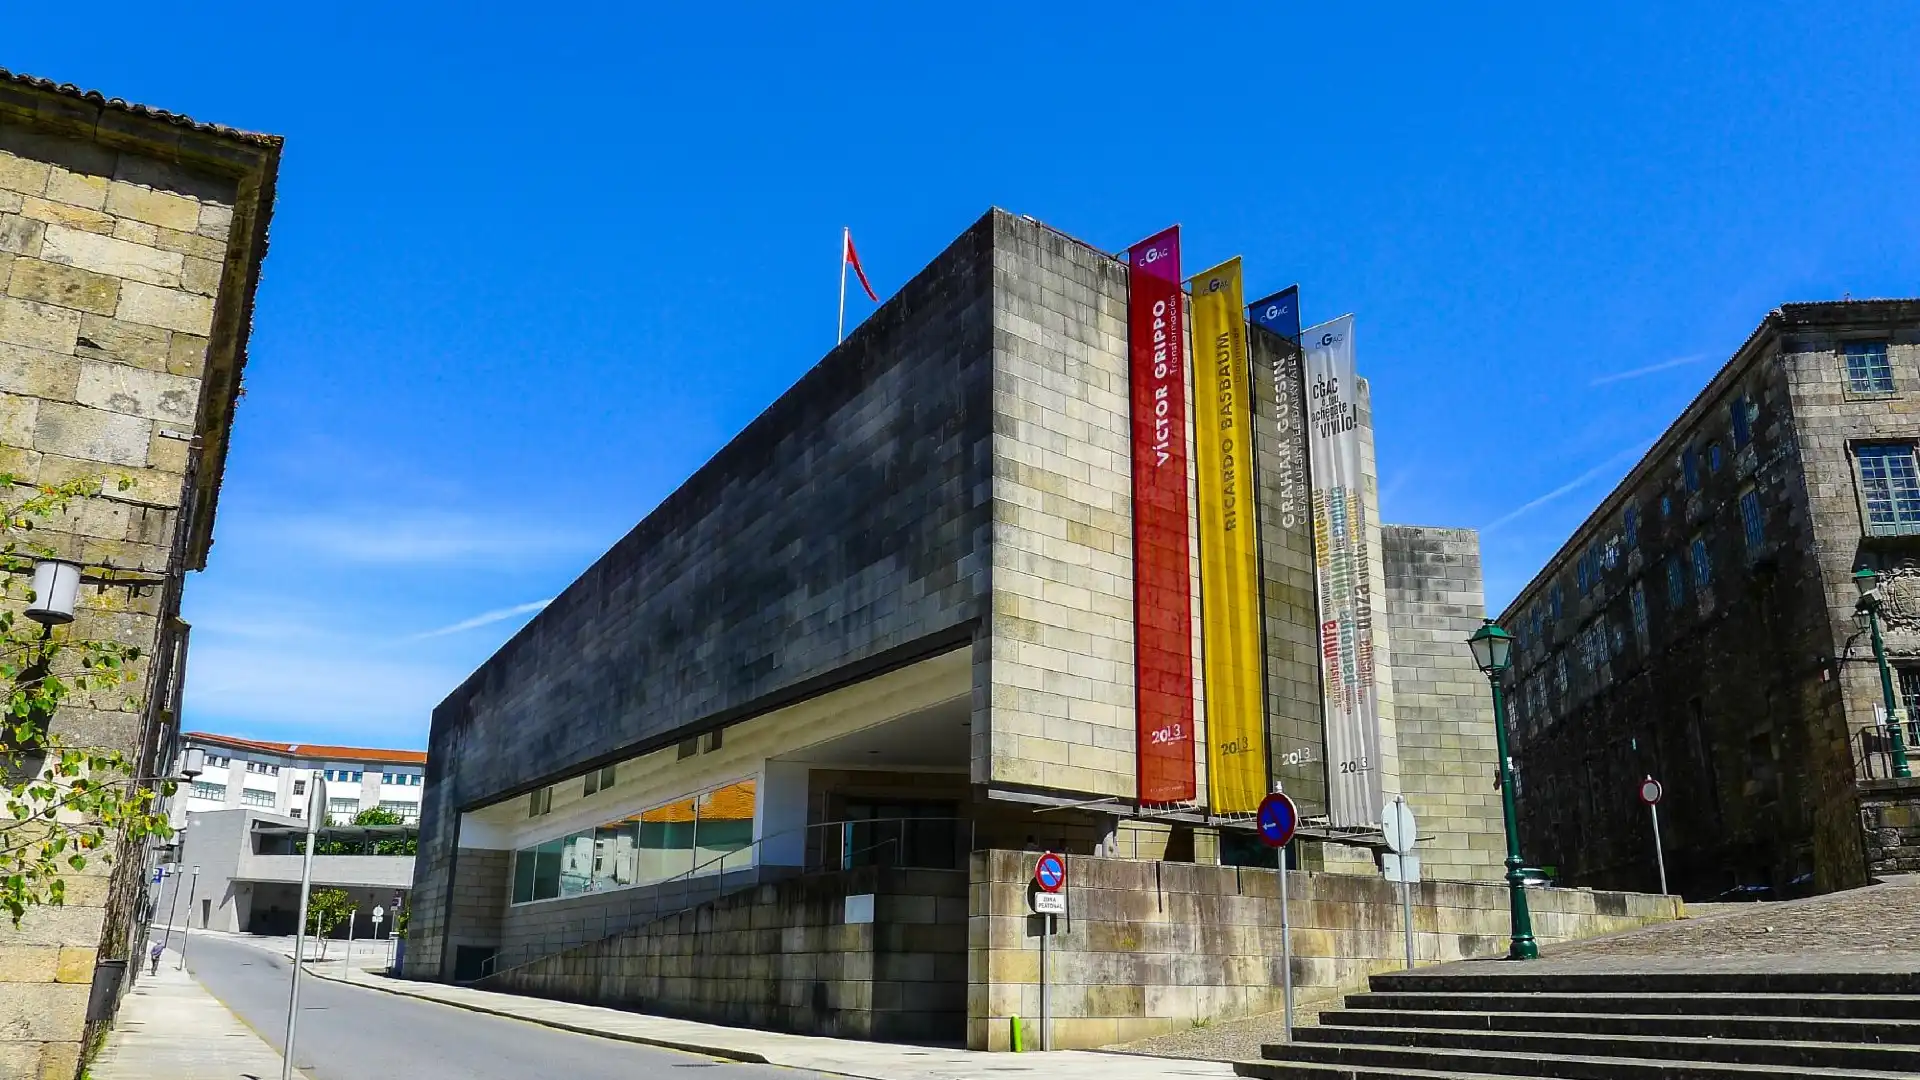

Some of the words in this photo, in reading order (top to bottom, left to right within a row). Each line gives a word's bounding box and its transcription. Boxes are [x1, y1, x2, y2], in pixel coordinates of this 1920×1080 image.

[1153, 300, 1167, 379] GRIPPO
[1168, 294, 1178, 375] Transformación
[1216, 331, 1233, 430] BASBAUM
[1273, 358, 1289, 433] GUSSIN
[1313, 377, 1338, 399] CGAC
[1152, 384, 1170, 467] VÍCTOR
[1320, 403, 1358, 438] vivilo!
[1222, 438, 1236, 531] RICARDO
[1278, 438, 1295, 528] GRAHAM
[1330, 486, 1346, 537] explora
[1355, 543, 1369, 579] visita
[1322, 620, 1337, 659] mira
[1339, 610, 1356, 685] participa
[1357, 640, 1373, 688] investiga
[1152, 723, 1181, 744] 2013
[1221, 736, 1249, 756] 2013
[1282, 747, 1311, 766] 2013
[1340, 757, 1368, 774] 2013
